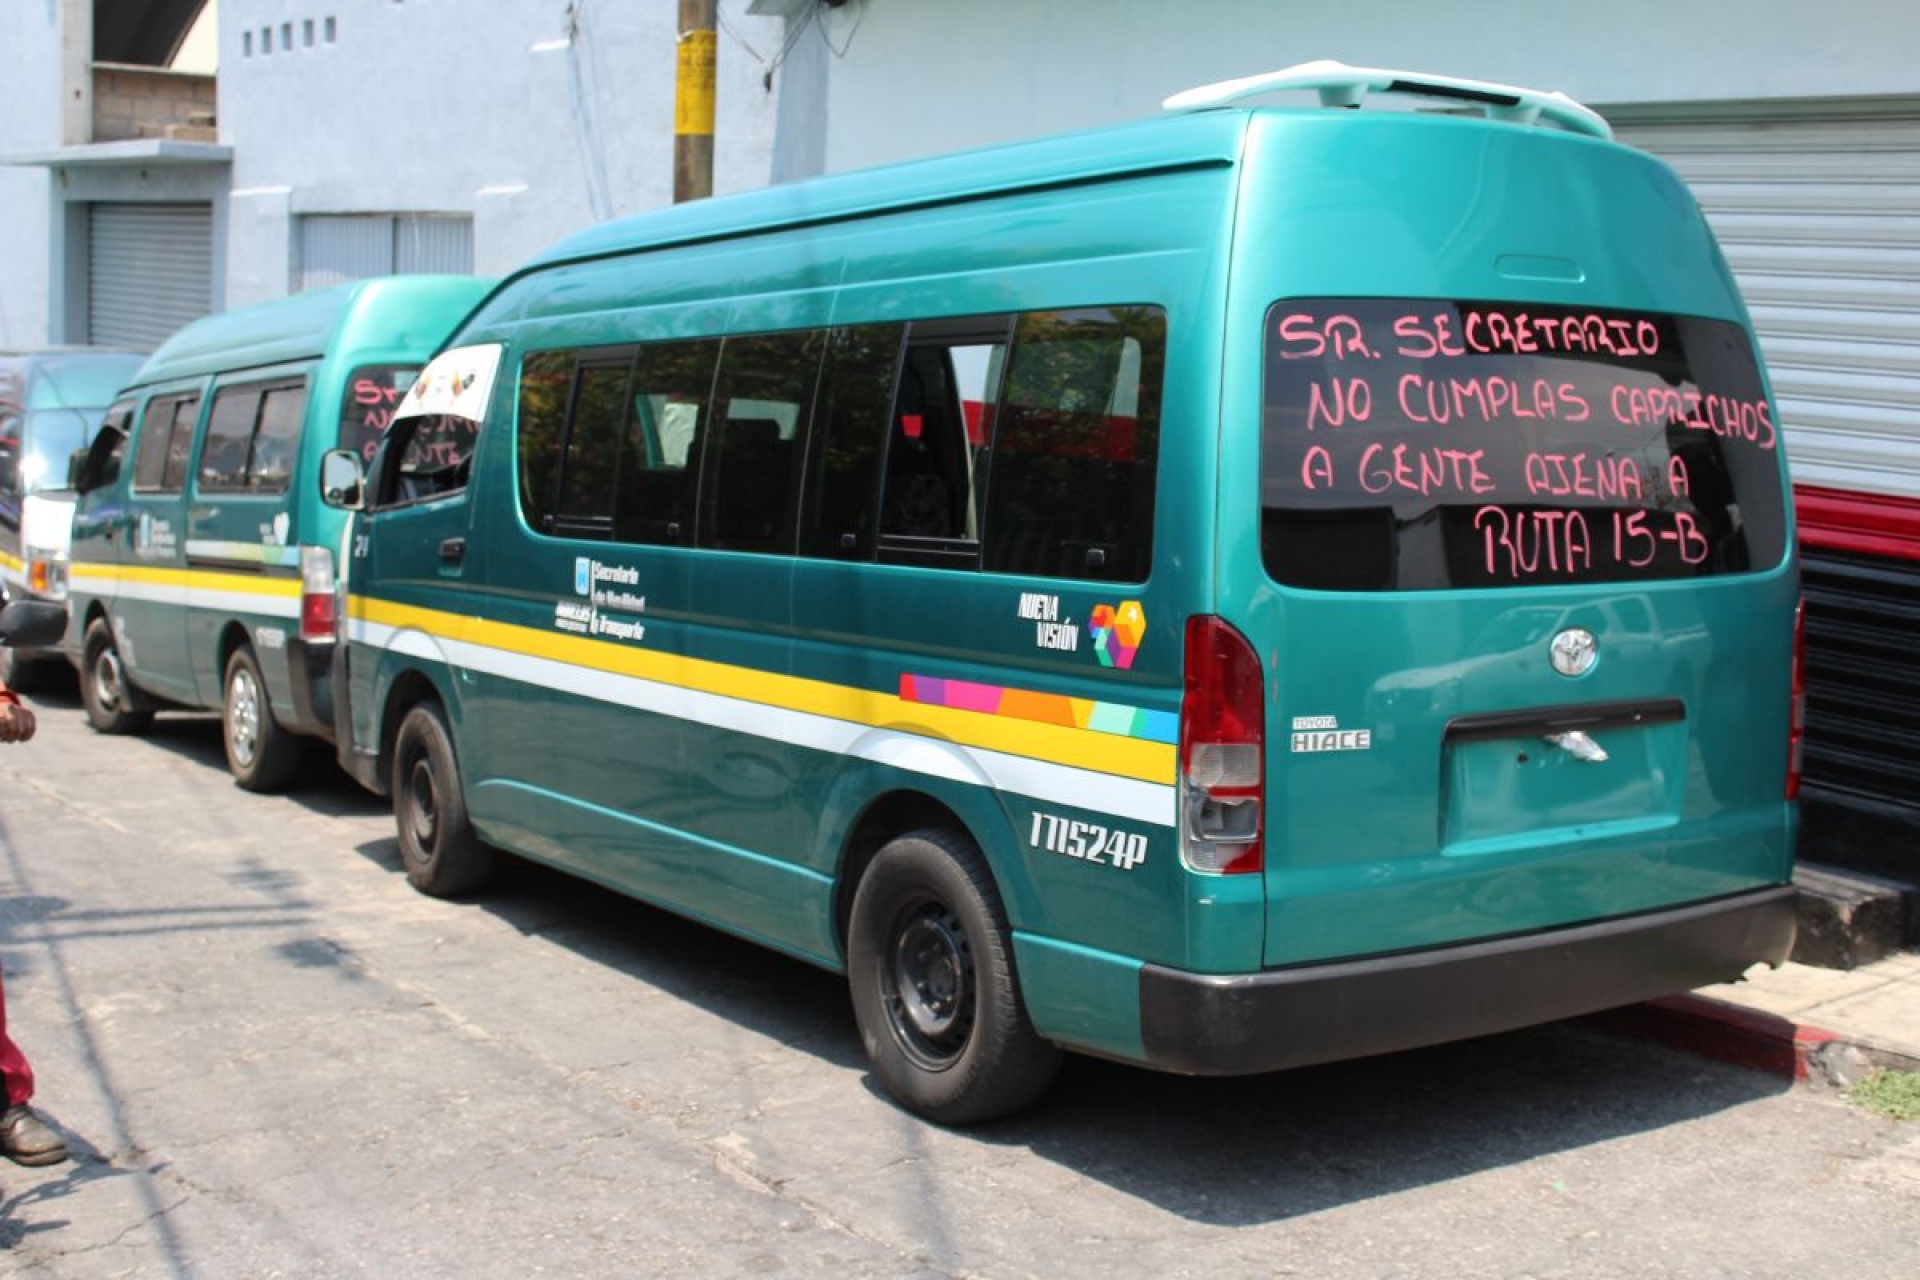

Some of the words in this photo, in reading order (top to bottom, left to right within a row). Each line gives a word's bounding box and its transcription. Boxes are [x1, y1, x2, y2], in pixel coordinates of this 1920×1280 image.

[1279, 314, 1381, 360] SR.
[1393, 311, 1660, 358] SECRETARIO
[1306, 377, 1372, 430] NO
[1398, 374, 1590, 424] CUMPLAS
[1611, 384, 1776, 450] CAPRICHOS
[1303, 446, 1334, 489] A
[1359, 443, 1496, 496] GENTE
[1525, 453, 1642, 500] AJENA
[1668, 455, 1690, 496] A
[1474, 504, 1592, 578] RUTA
[1612, 509, 1709, 568] 15-B
[1018, 592, 1059, 622] NUEVA
[1292, 731, 1370, 752] HIACE
[1294, 717, 1337, 729] TOYOTA
